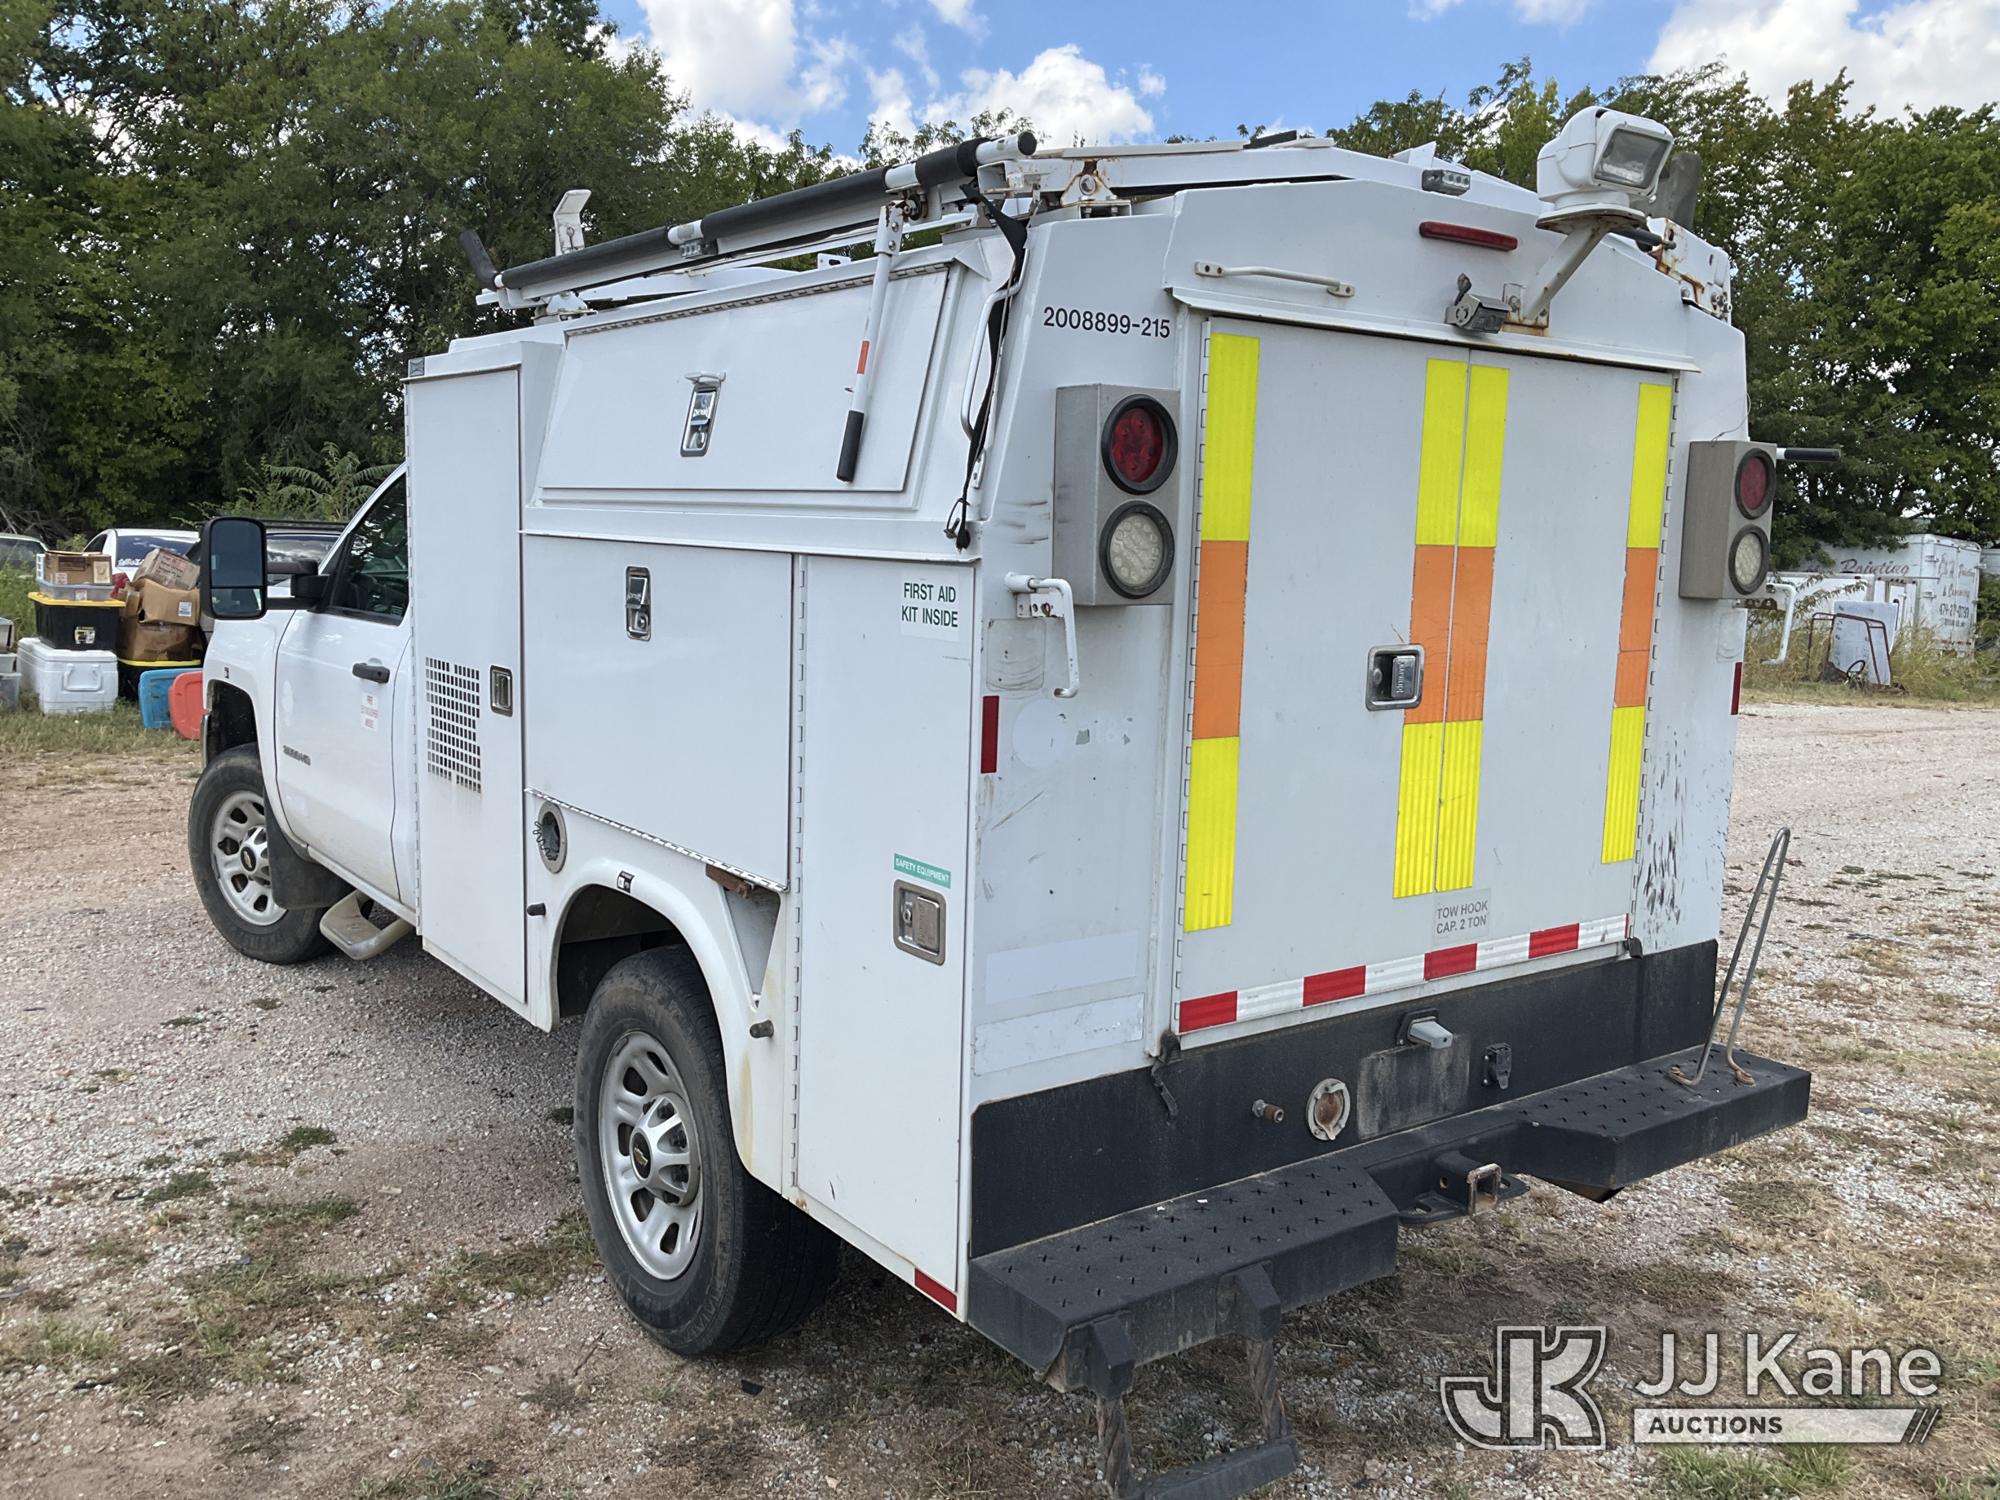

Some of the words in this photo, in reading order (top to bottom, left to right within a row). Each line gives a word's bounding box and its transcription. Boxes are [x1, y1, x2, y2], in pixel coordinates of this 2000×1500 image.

[1043, 306, 1170, 338] 2008899-215
[903, 582, 934, 600] FIRST
[938, 585, 956, 602] AID
[901, 605, 918, 622] KIT
[922, 607, 958, 627] INSIDE
[895, 857, 916, 872] SAFETY
[916, 865, 949, 882] EQUIPMENT
[1437, 905, 1458, 919] TOW
[1461, 900, 1488, 914] HOOK
[1436, 920, 1457, 934] CAP.
[1460, 918, 1466, 930] 2
[1468, 914, 1487, 928] TON
